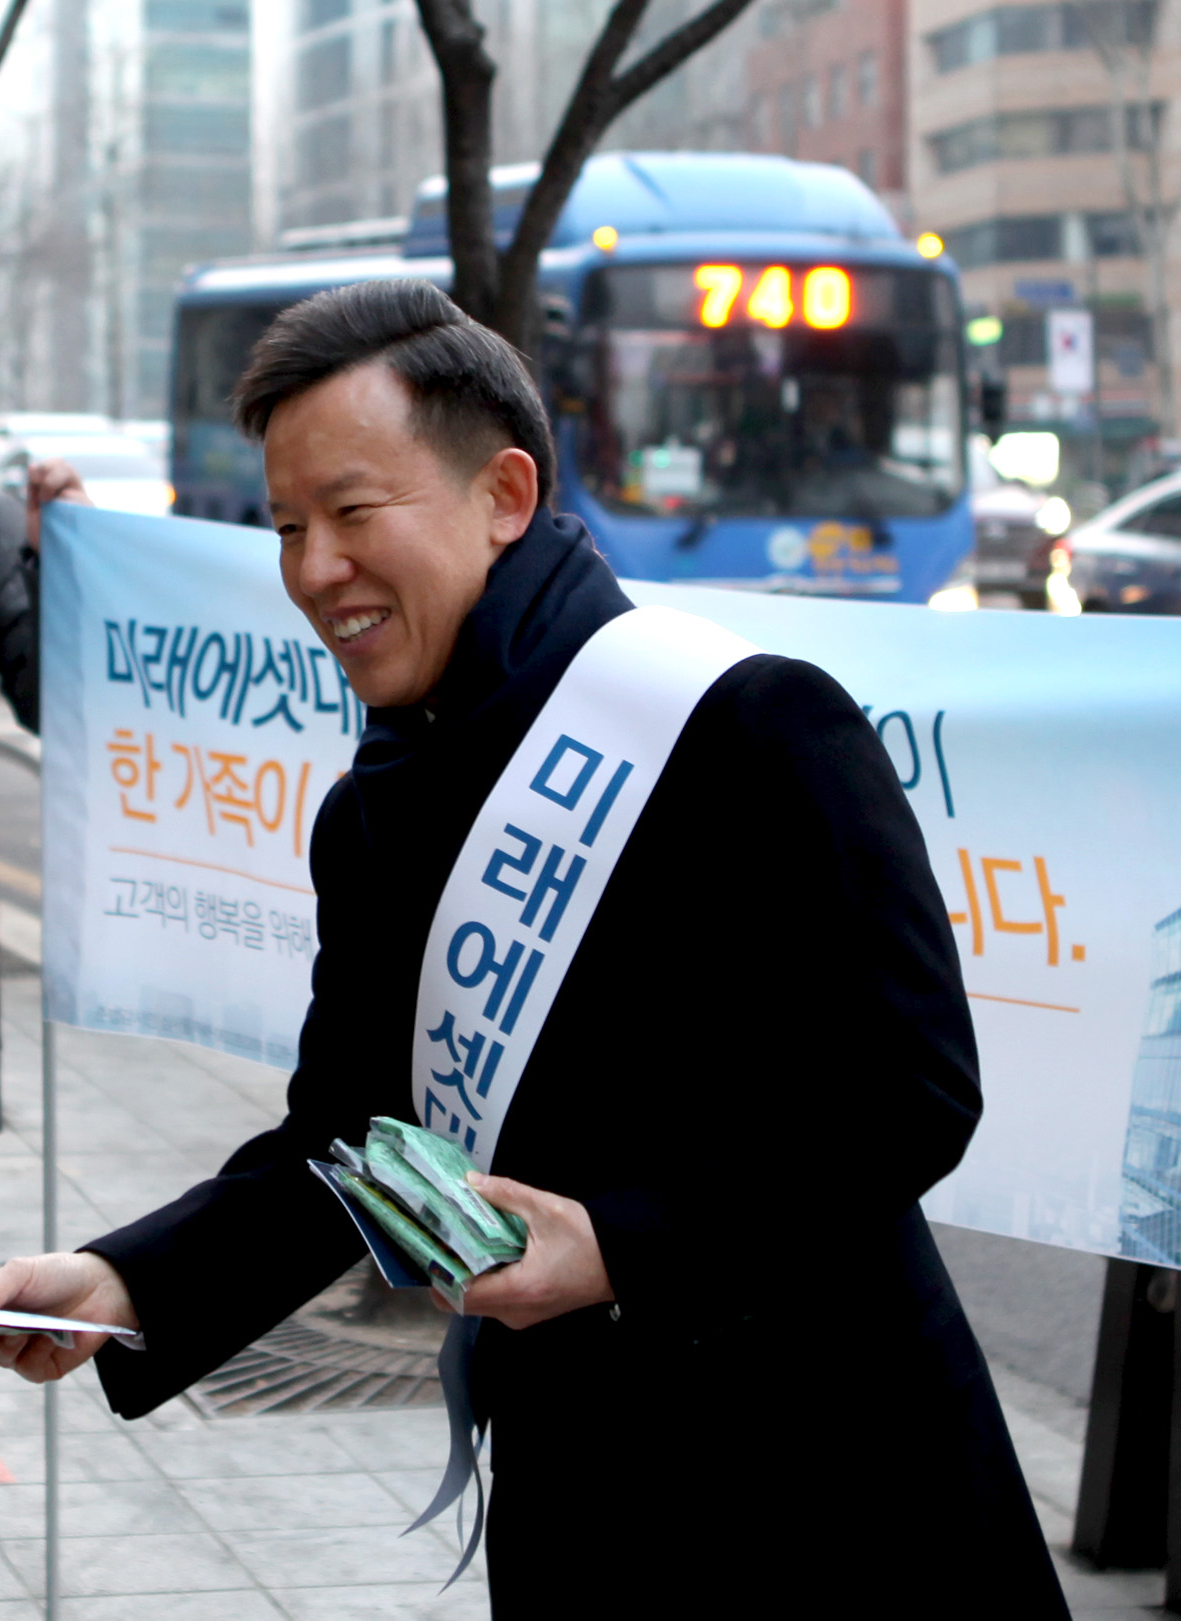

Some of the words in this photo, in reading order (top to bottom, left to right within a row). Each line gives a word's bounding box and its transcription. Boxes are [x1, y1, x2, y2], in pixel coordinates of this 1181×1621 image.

[694, 262, 852, 329] 740
[103, 876, 189, 933] 고객의
[194, 889, 266, 951] 행복을
